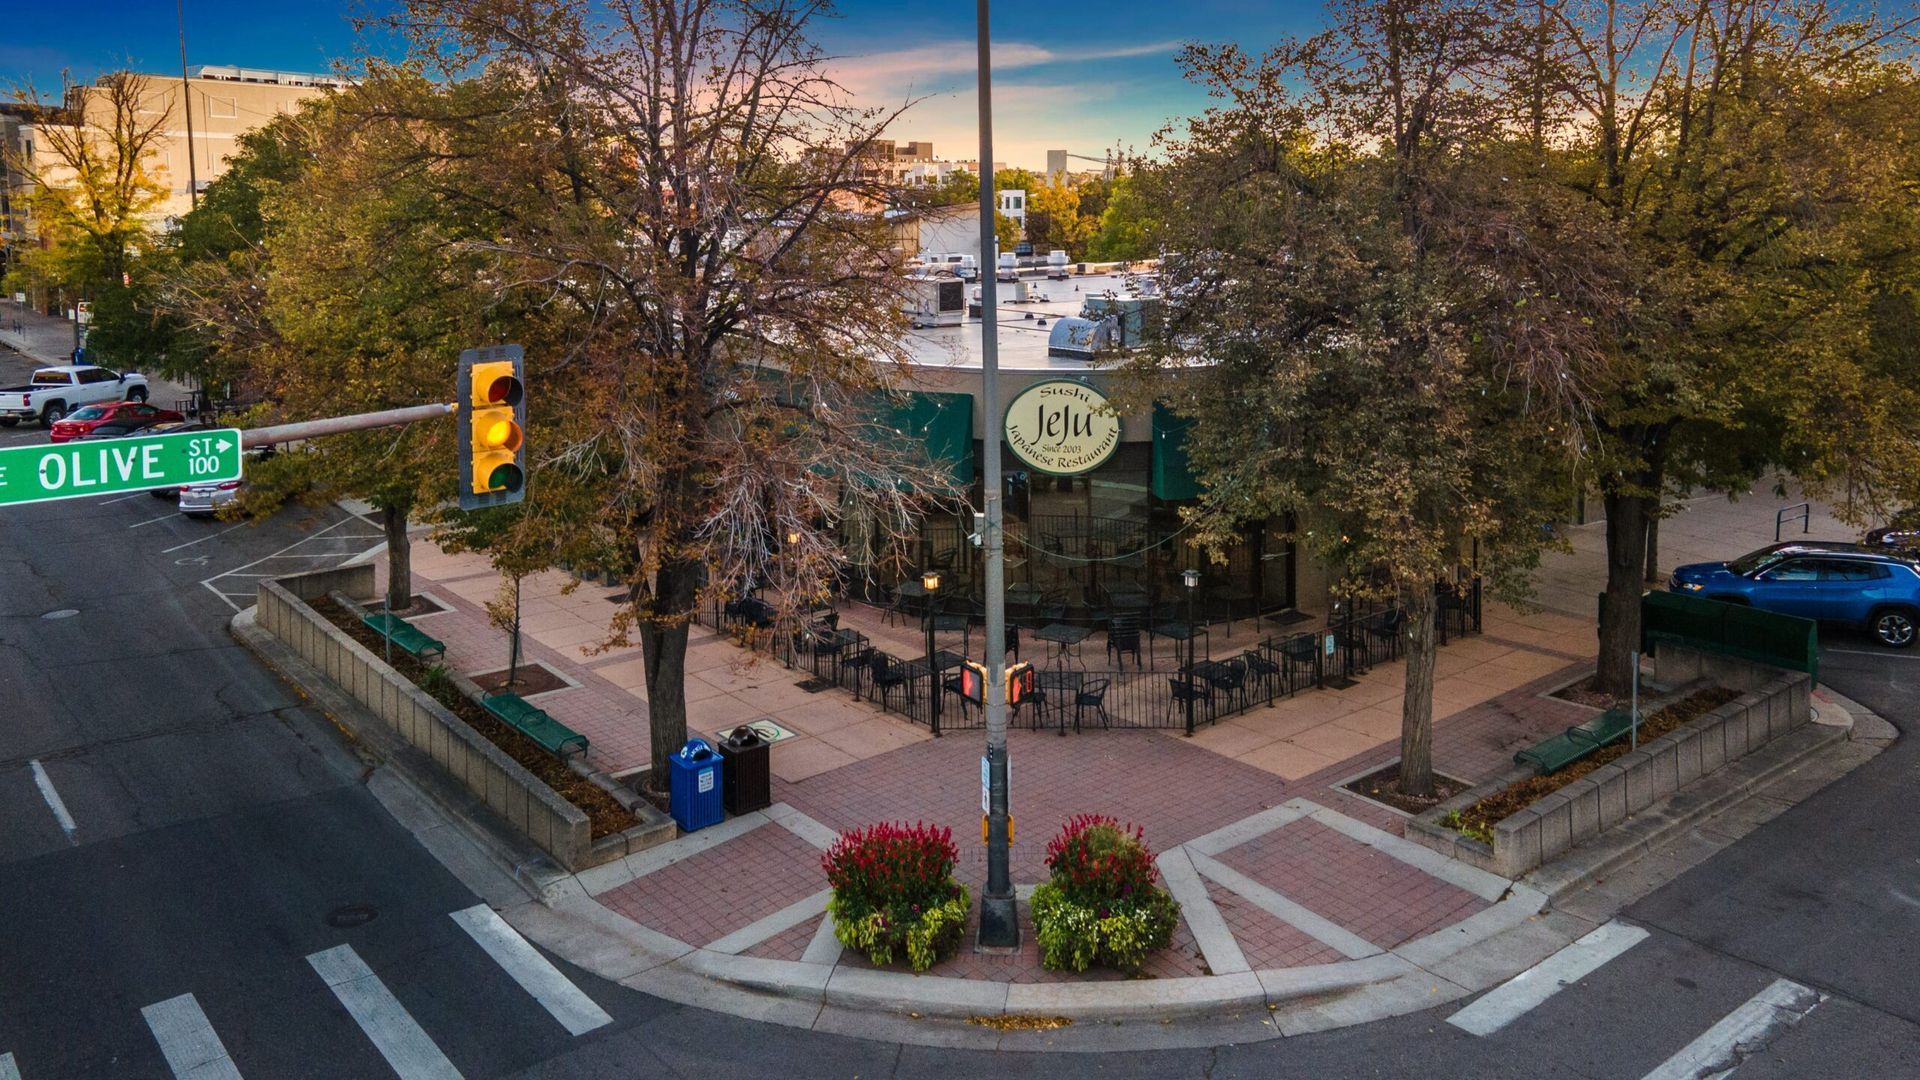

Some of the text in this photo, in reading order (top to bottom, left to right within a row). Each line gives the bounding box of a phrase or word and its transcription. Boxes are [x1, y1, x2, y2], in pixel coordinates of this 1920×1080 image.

[189, 438, 213, 457] ST
[1006, 424, 1118, 468] Japanese Restaurant
[1042, 443, 1082, 454] Since 2003
[38, 443, 165, 490] OLIVE
[189, 455, 220, 476] 100
